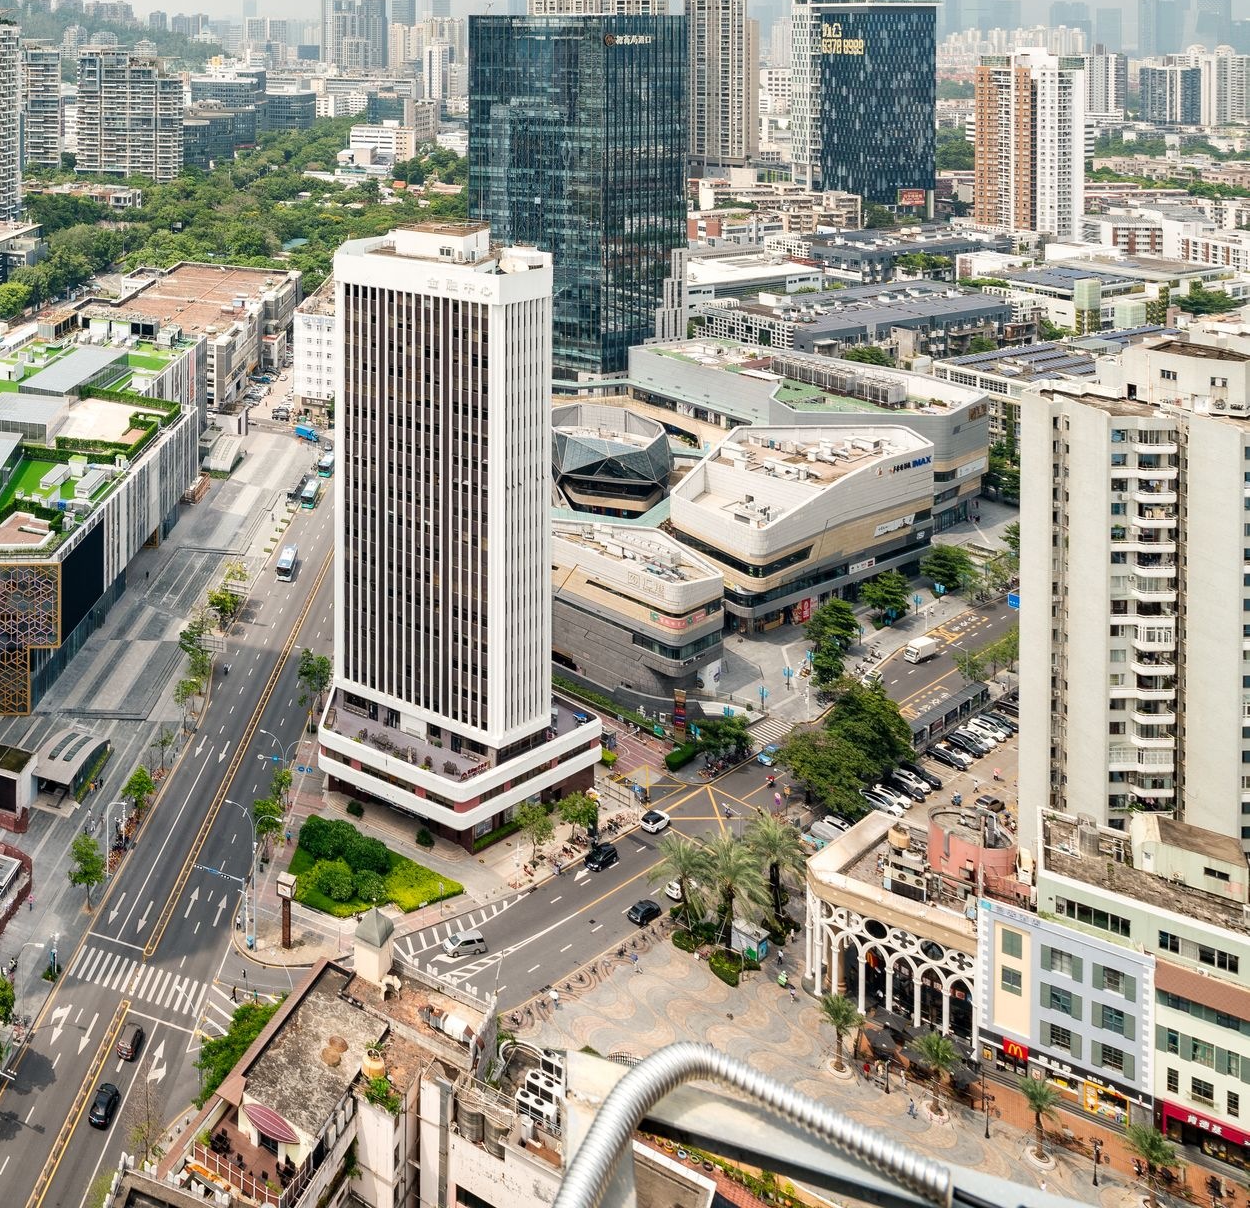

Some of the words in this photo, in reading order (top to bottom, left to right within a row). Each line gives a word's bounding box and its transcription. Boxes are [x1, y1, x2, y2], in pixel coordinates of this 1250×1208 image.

[911, 455, 932, 468] IMAX
[1187, 1113, 1222, 1136] 肯德基
